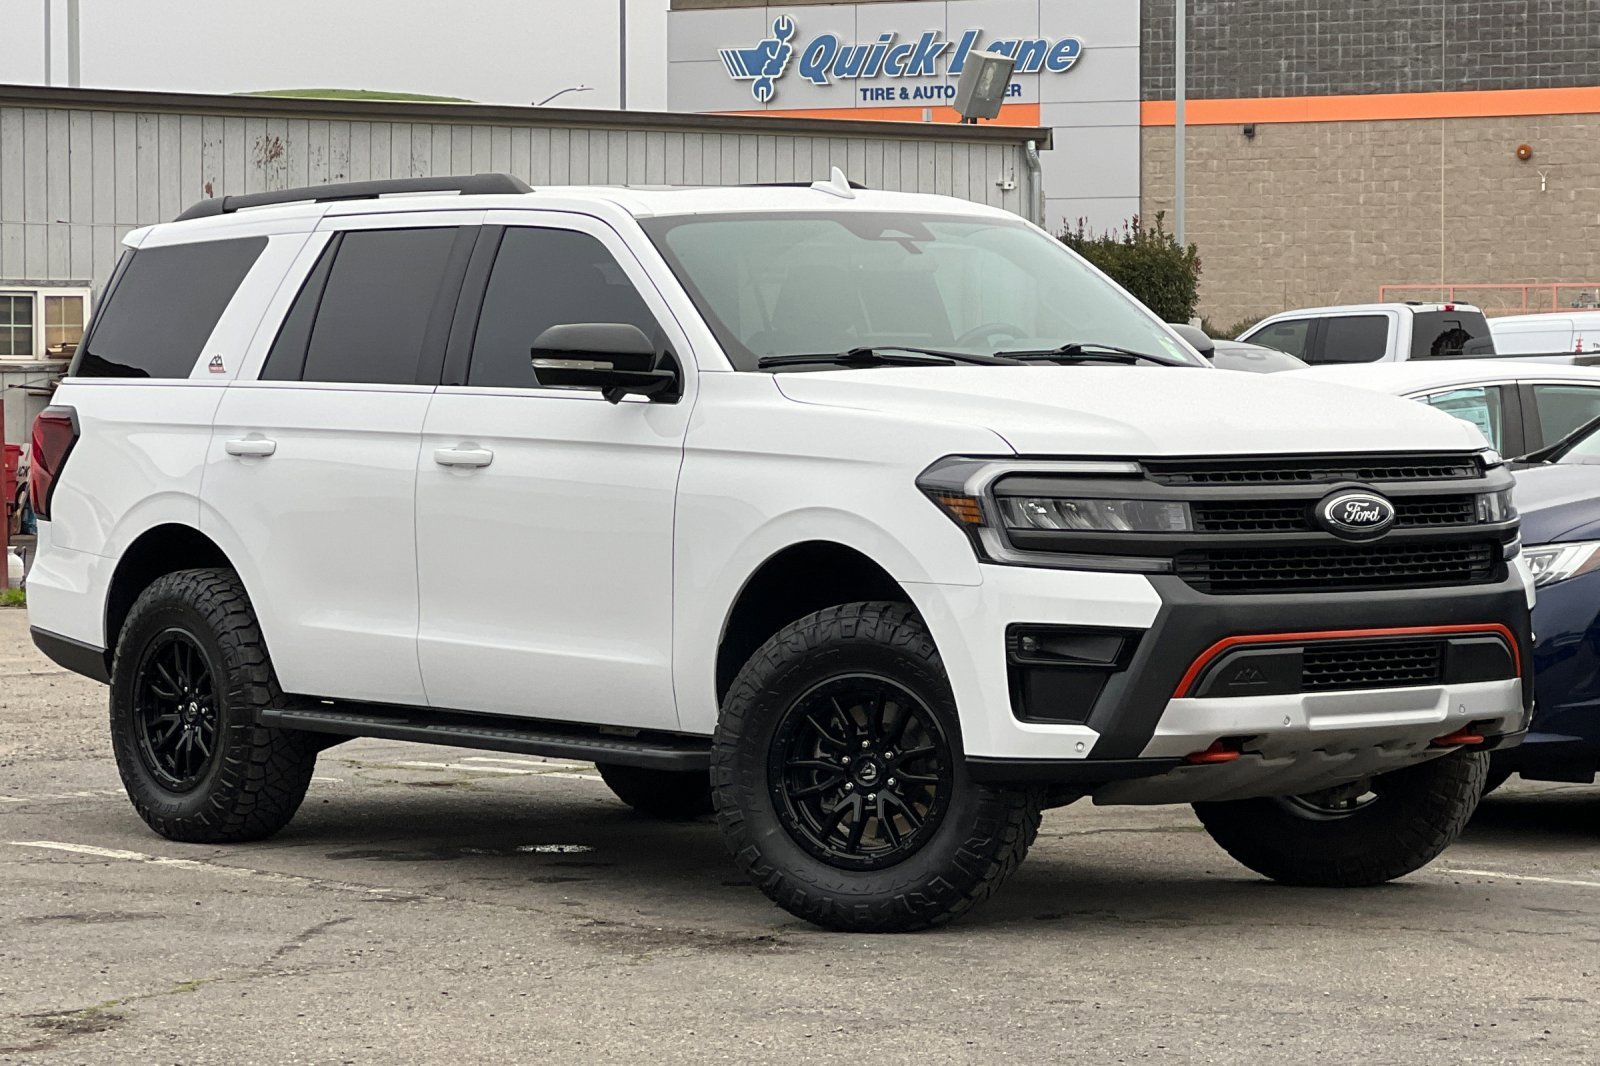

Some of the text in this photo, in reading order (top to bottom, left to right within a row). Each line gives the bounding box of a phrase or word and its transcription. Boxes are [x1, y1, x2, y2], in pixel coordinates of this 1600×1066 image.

[798, 31, 949, 85] Quick
[860, 87, 895, 101] TIRE
[900, 87, 909, 100] &
[913, 85, 956, 101] AUTO
[1344, 501, 1380, 522] Ford
